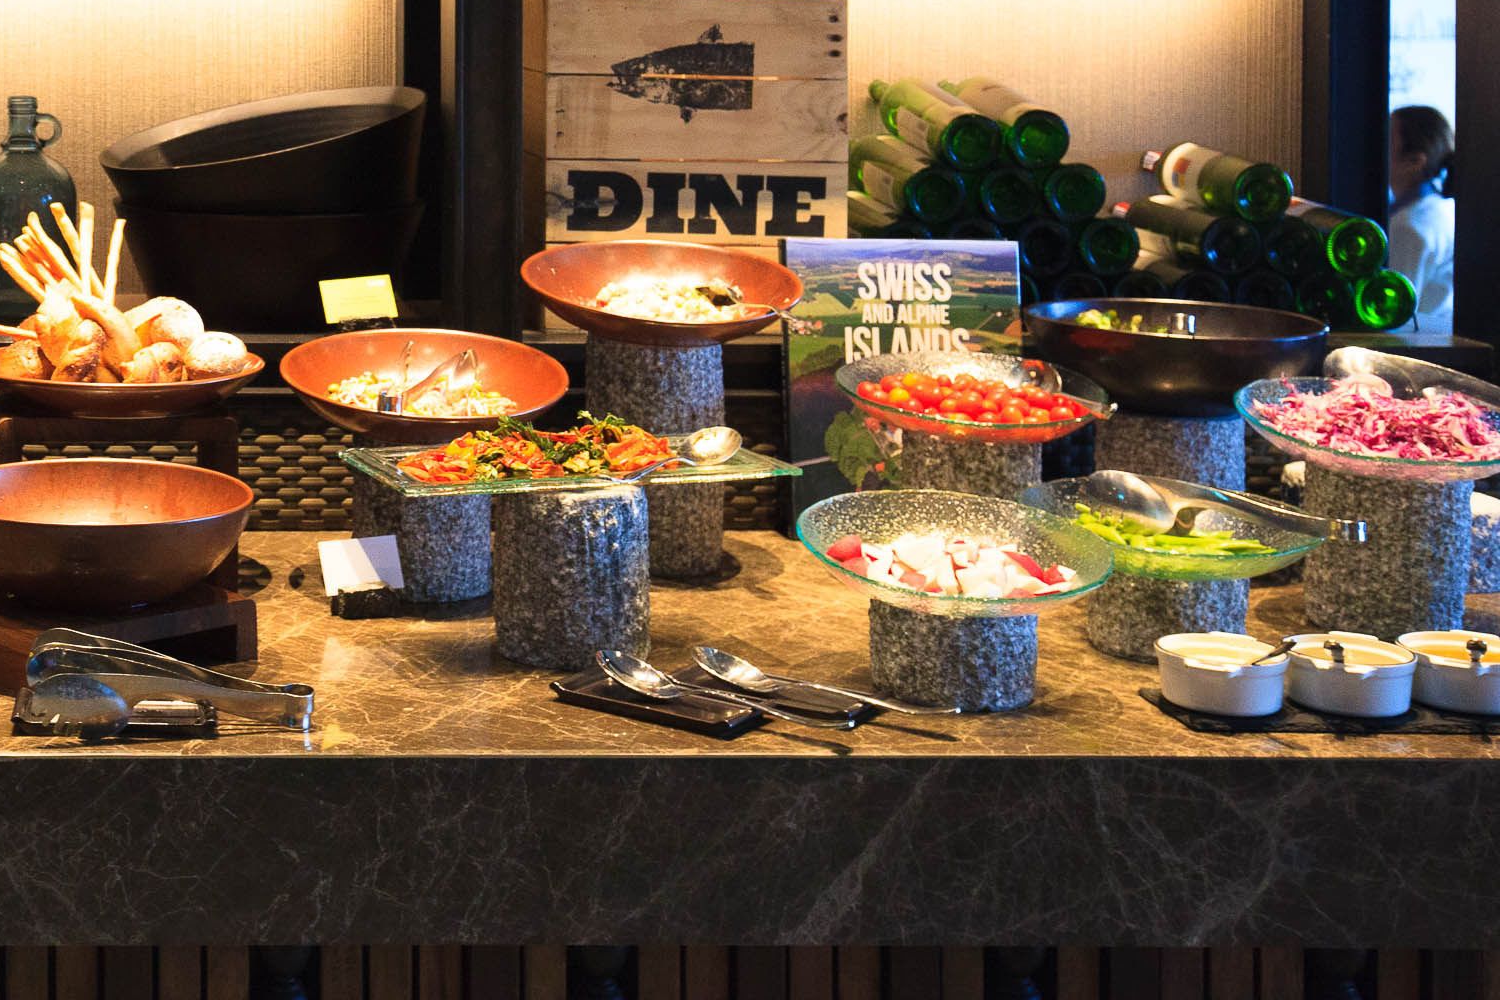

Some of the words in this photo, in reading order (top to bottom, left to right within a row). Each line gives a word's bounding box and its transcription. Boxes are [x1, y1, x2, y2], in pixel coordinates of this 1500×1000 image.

[567, 170, 827, 237] DINE
[857, 261, 952, 302] SWISS
[862, 304, 894, 324] AND
[897, 304, 951, 325] ALPINE
